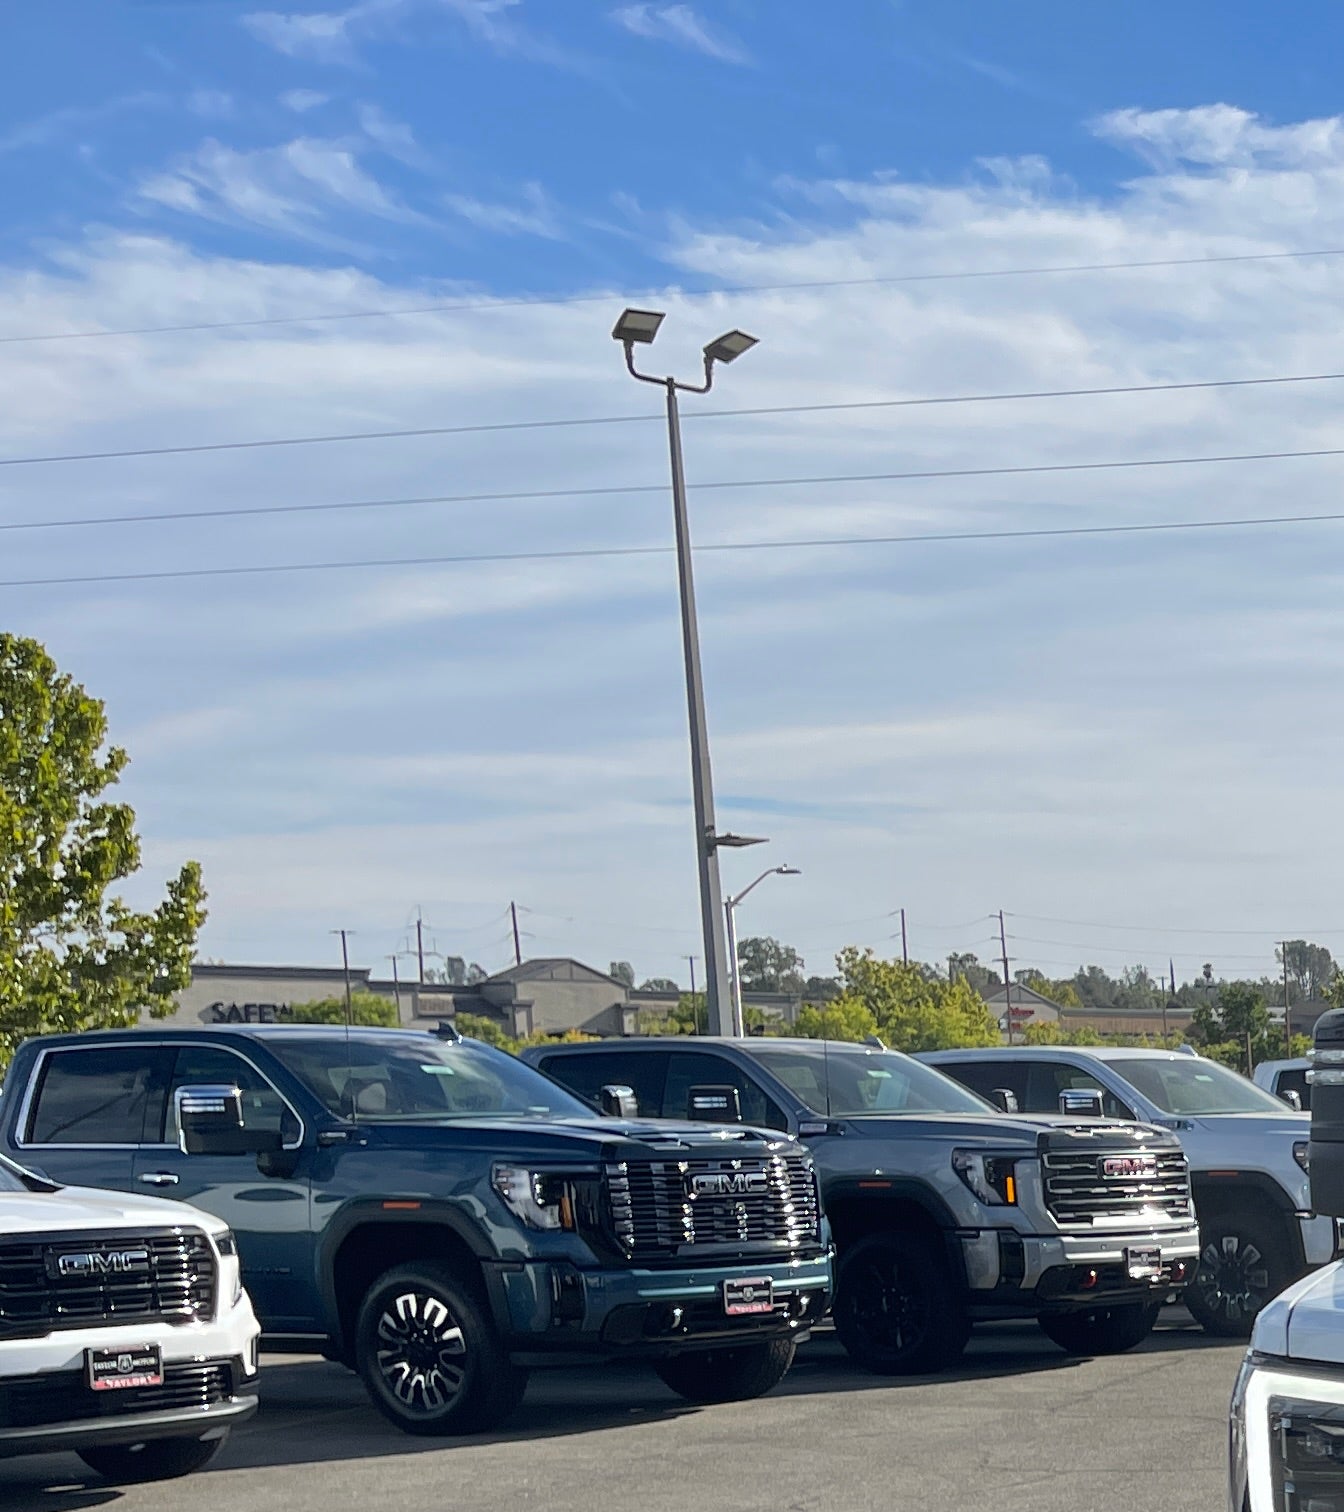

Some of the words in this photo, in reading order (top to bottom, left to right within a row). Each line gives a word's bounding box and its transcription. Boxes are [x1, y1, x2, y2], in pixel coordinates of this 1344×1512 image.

[211, 1001, 294, 1024] SAFEW
[691, 1172, 768, 1194] GMC
[58, 1250, 149, 1276] GMC
